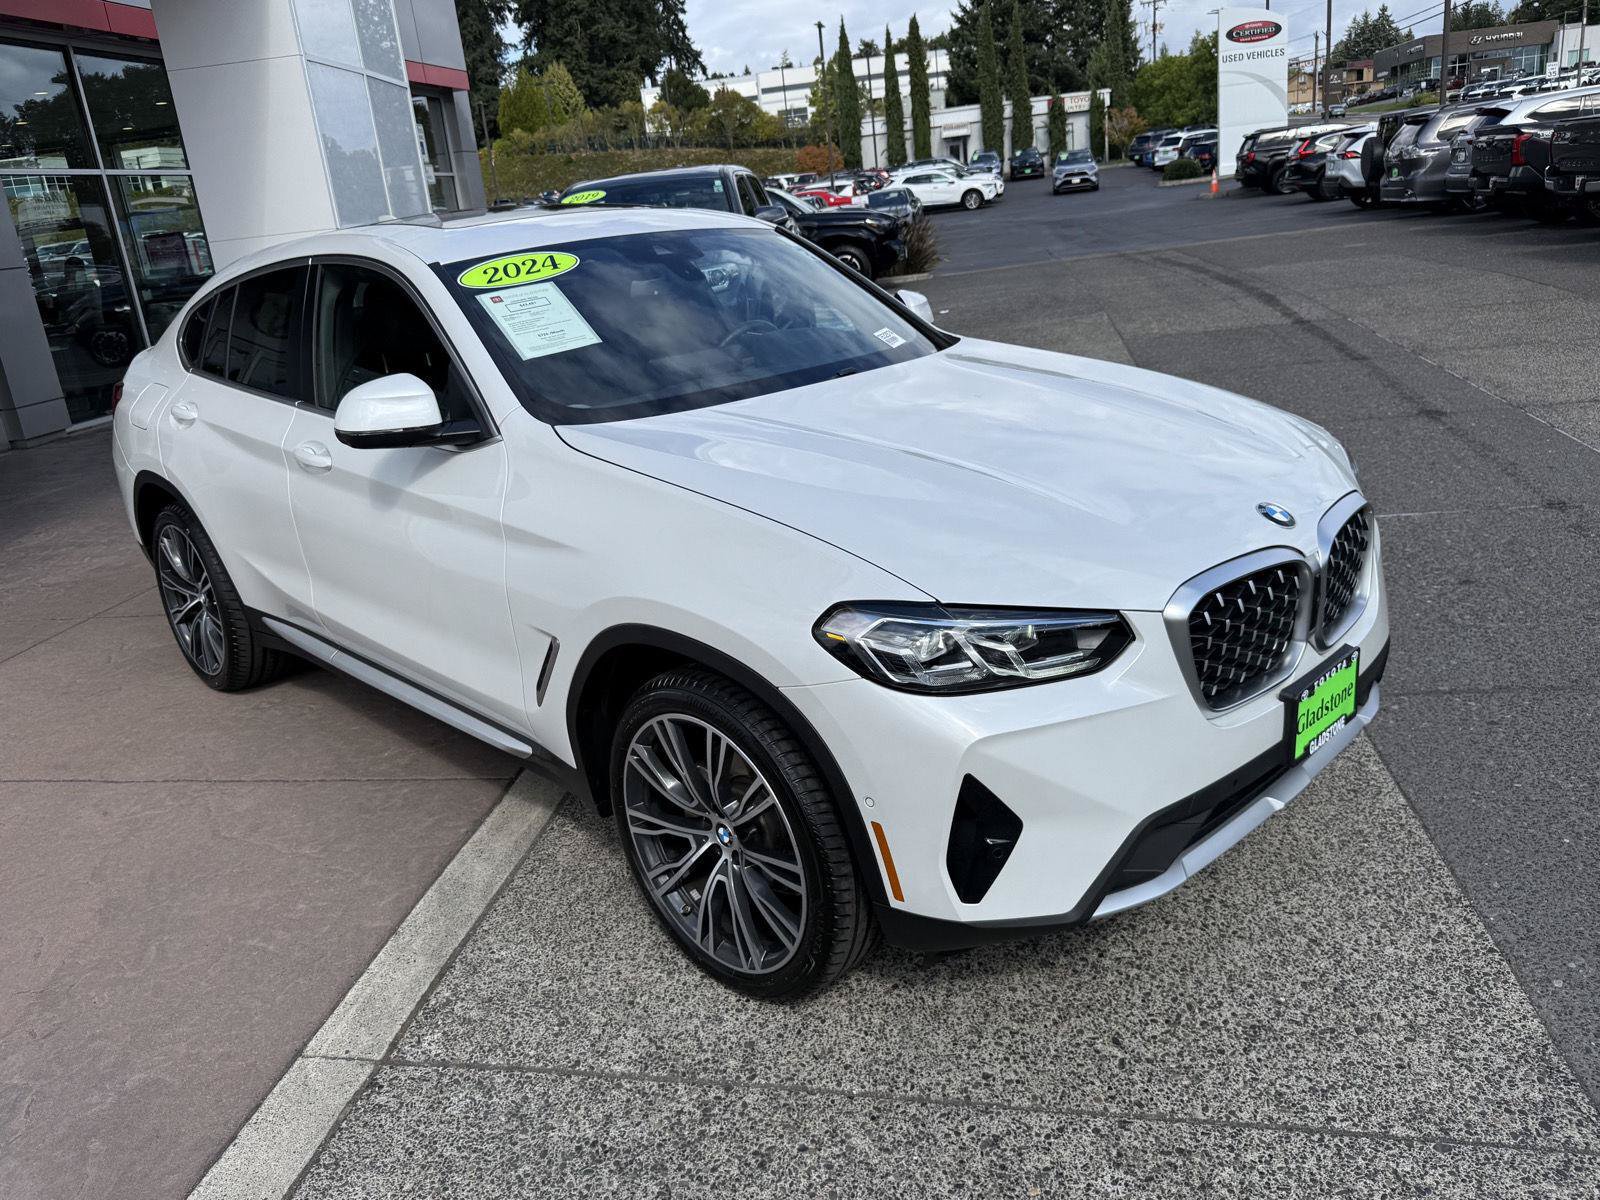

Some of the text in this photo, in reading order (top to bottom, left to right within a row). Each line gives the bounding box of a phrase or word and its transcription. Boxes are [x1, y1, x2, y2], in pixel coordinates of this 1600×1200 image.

[1222, 48, 1285, 63] USED VEHICLES
[1069, 96, 1091, 105] TOYO
[483, 255, 561, 285] 2024
[1314, 660, 1347, 690] TOYOTA
[1297, 682, 1354, 735] Gladstone
[1309, 715, 1346, 755] GLADSTONE
